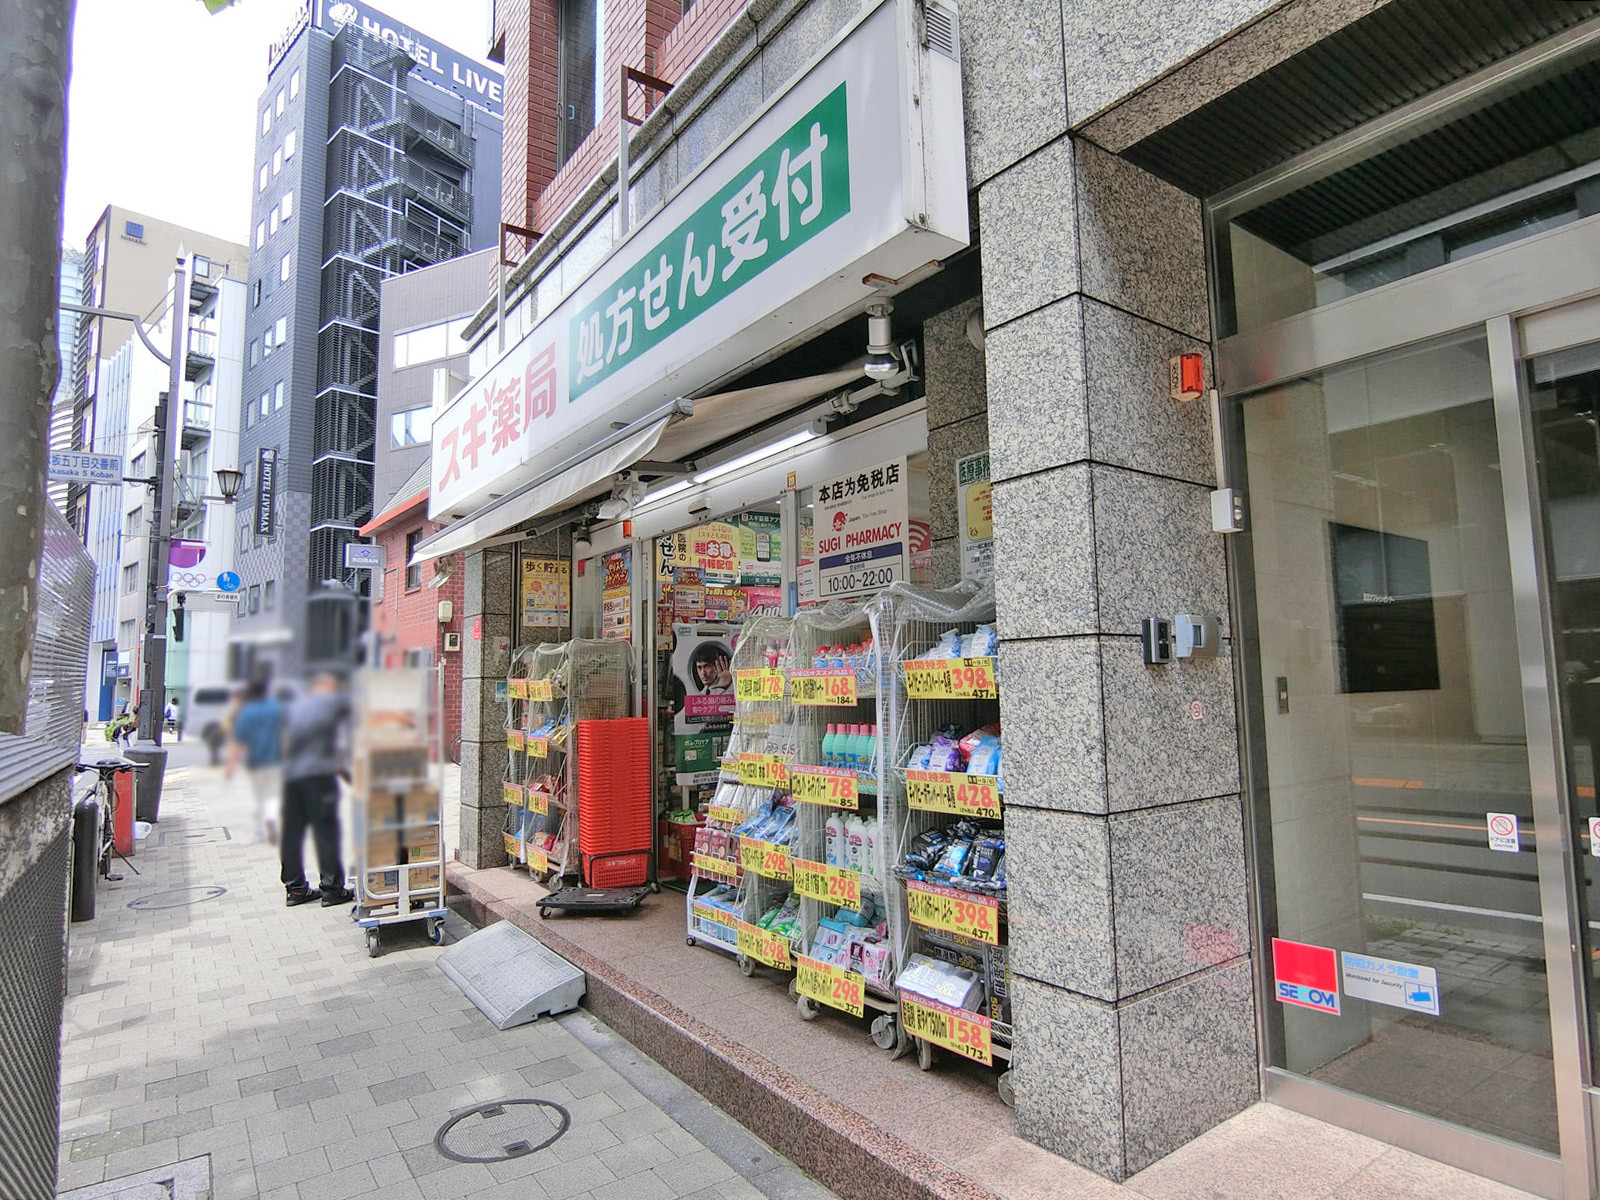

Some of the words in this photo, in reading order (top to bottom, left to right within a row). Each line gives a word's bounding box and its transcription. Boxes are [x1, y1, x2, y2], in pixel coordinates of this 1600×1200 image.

[362, 15, 444, 75] HOTEL
[576, 121, 829, 386] 処方せん受付
[438, 341, 557, 493] スギ薬局
[48, 453, 118, 471] 坂五丁目交番前
[91, 470, 114, 479] Koban
[263, 462, 272, 492] HOTEL
[819, 463, 900, 504] 本店为免税店
[261, 493, 271, 533] LIVEMAX
[818, 537, 841, 554] SUGI
[845, 522, 902, 548] PHARMACY
[660, 535, 675, 575] せん
[1344, 955, 1418, 979] 防犯カメラ設置
[1345, 972, 1371, 982] Monitored
[1381, 980, 1403, 989] Security
[1279, 982, 1335, 1008] SECOM
